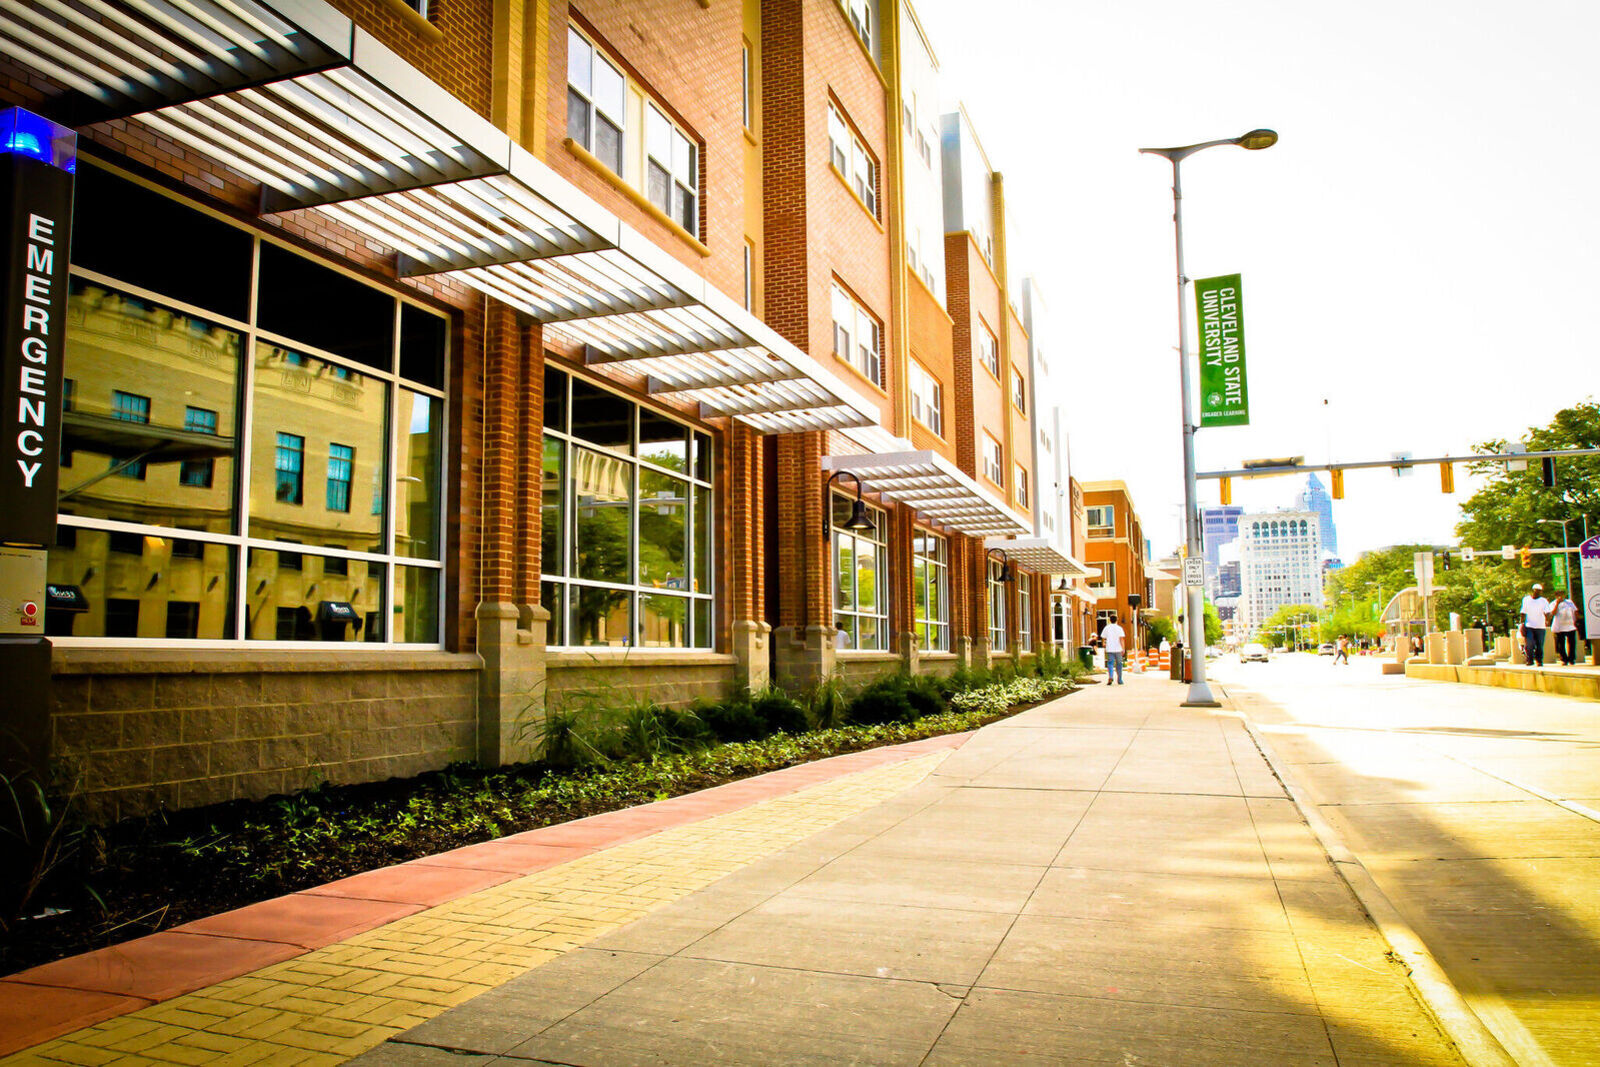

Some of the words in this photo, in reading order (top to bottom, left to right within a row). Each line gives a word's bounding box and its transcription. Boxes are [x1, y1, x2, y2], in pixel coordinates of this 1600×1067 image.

[17, 213, 55, 487] EMERGENCY
[1202, 289, 1222, 367] UNIVERSITY
[1220, 287, 1239, 363] CLEVELAND
[1224, 367, 1242, 406] STATE
